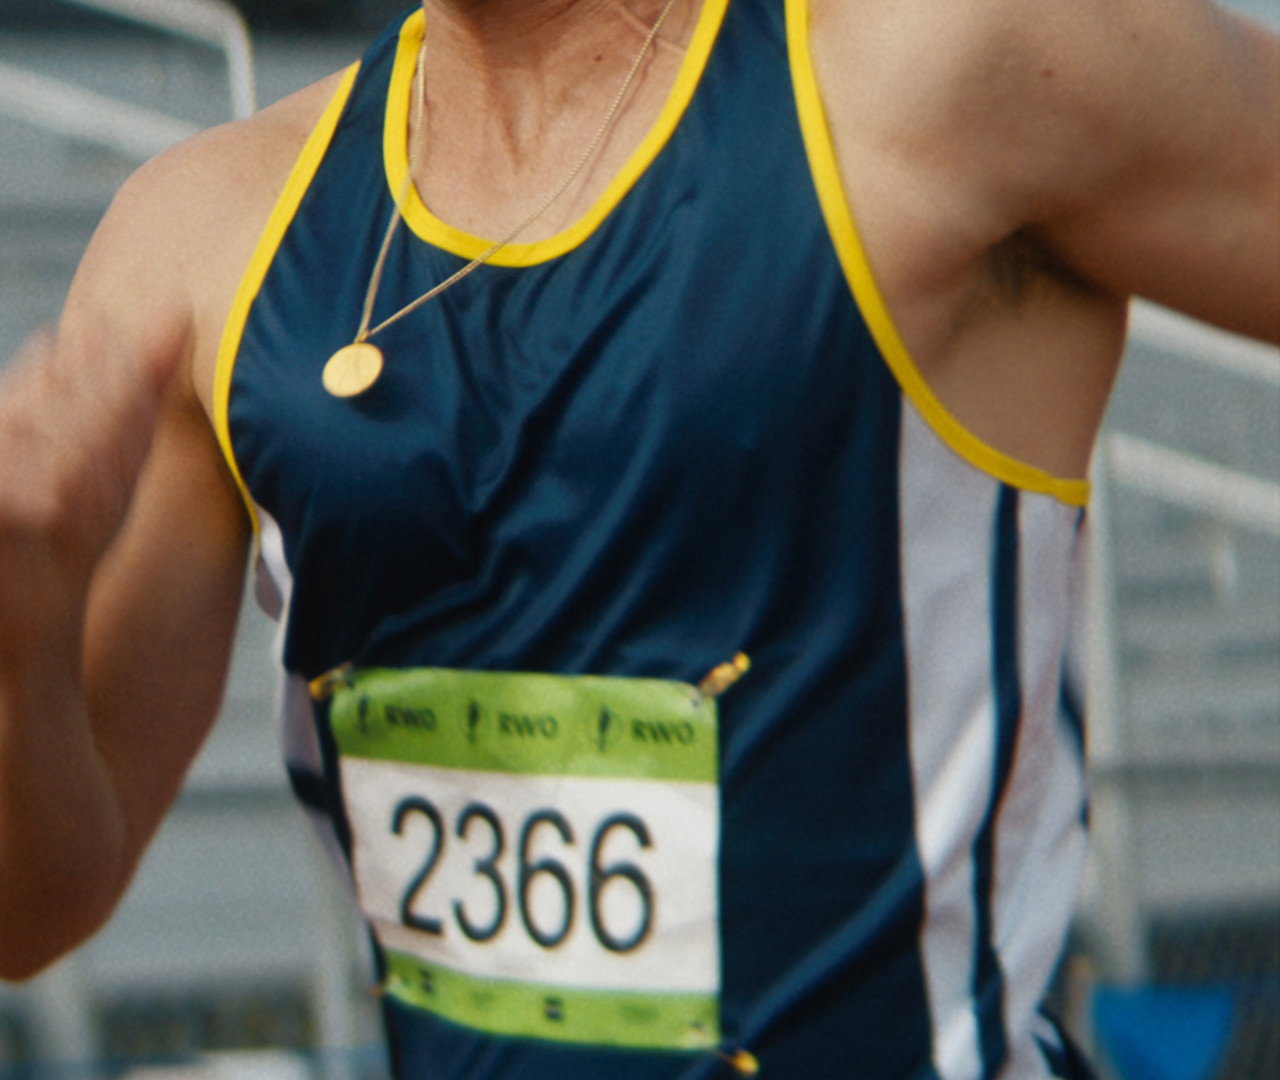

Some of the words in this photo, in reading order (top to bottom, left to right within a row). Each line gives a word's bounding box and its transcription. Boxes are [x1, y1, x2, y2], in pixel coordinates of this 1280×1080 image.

[498, 713, 559, 739] RWO
[633, 719, 695, 745] RWO
[391, 796, 655, 952] 2366
